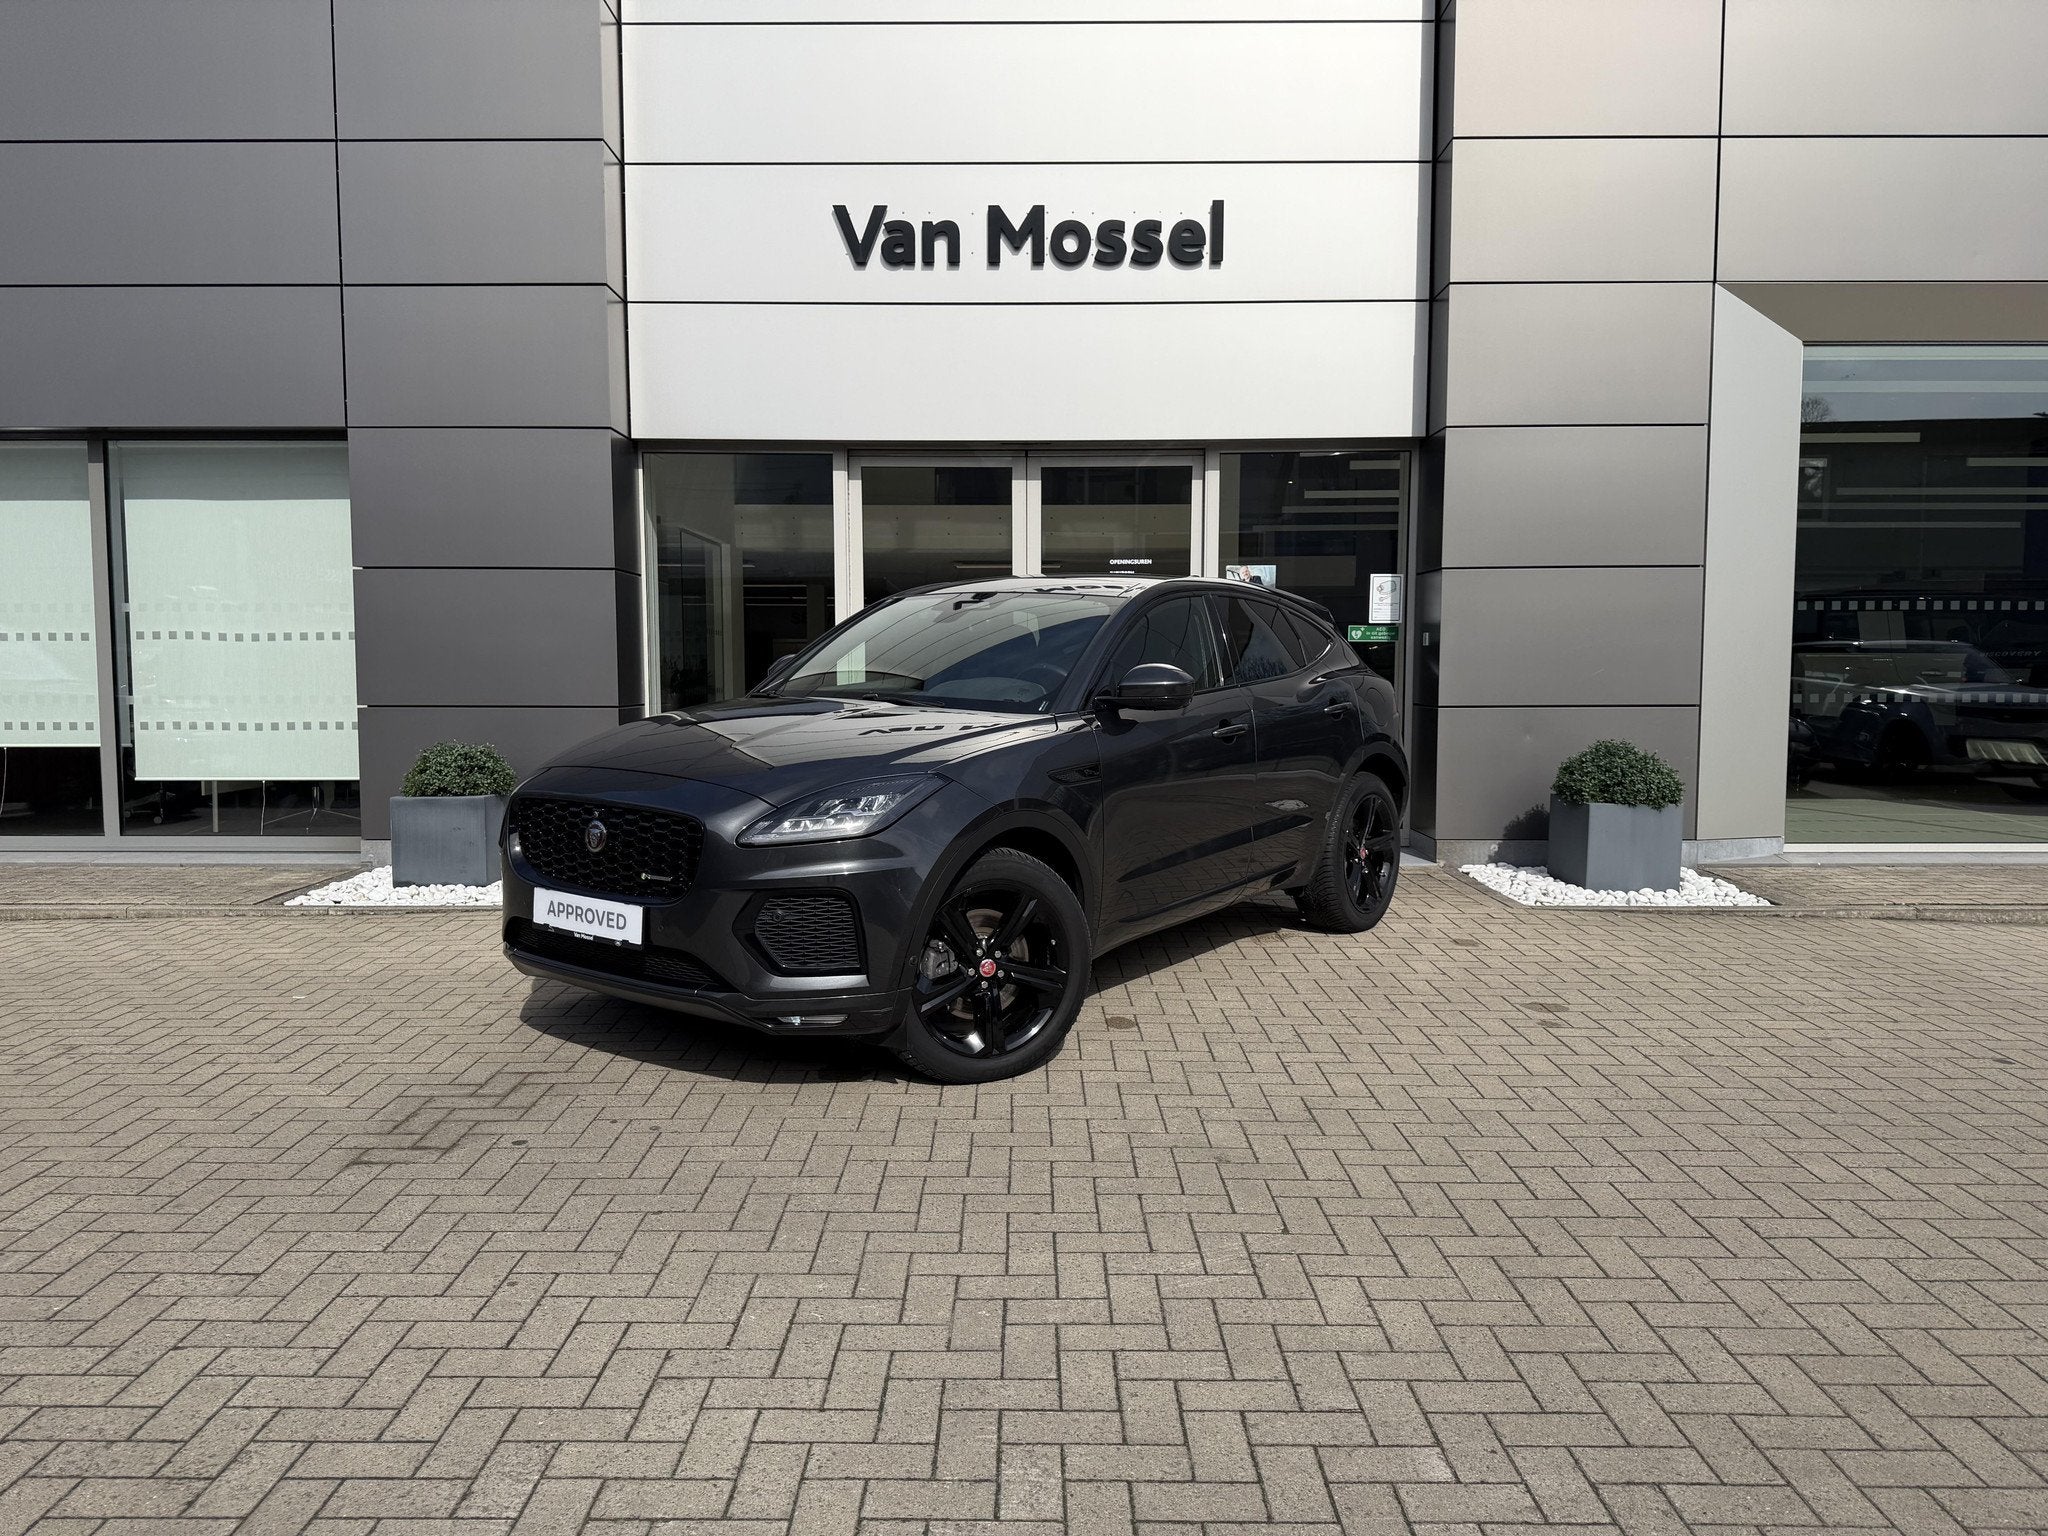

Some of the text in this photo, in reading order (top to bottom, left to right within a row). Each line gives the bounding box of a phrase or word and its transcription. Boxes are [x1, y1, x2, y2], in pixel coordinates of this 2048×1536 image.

[832, 199, 1225, 266] Van Mossel
[547, 900, 627, 930] APPROVED
